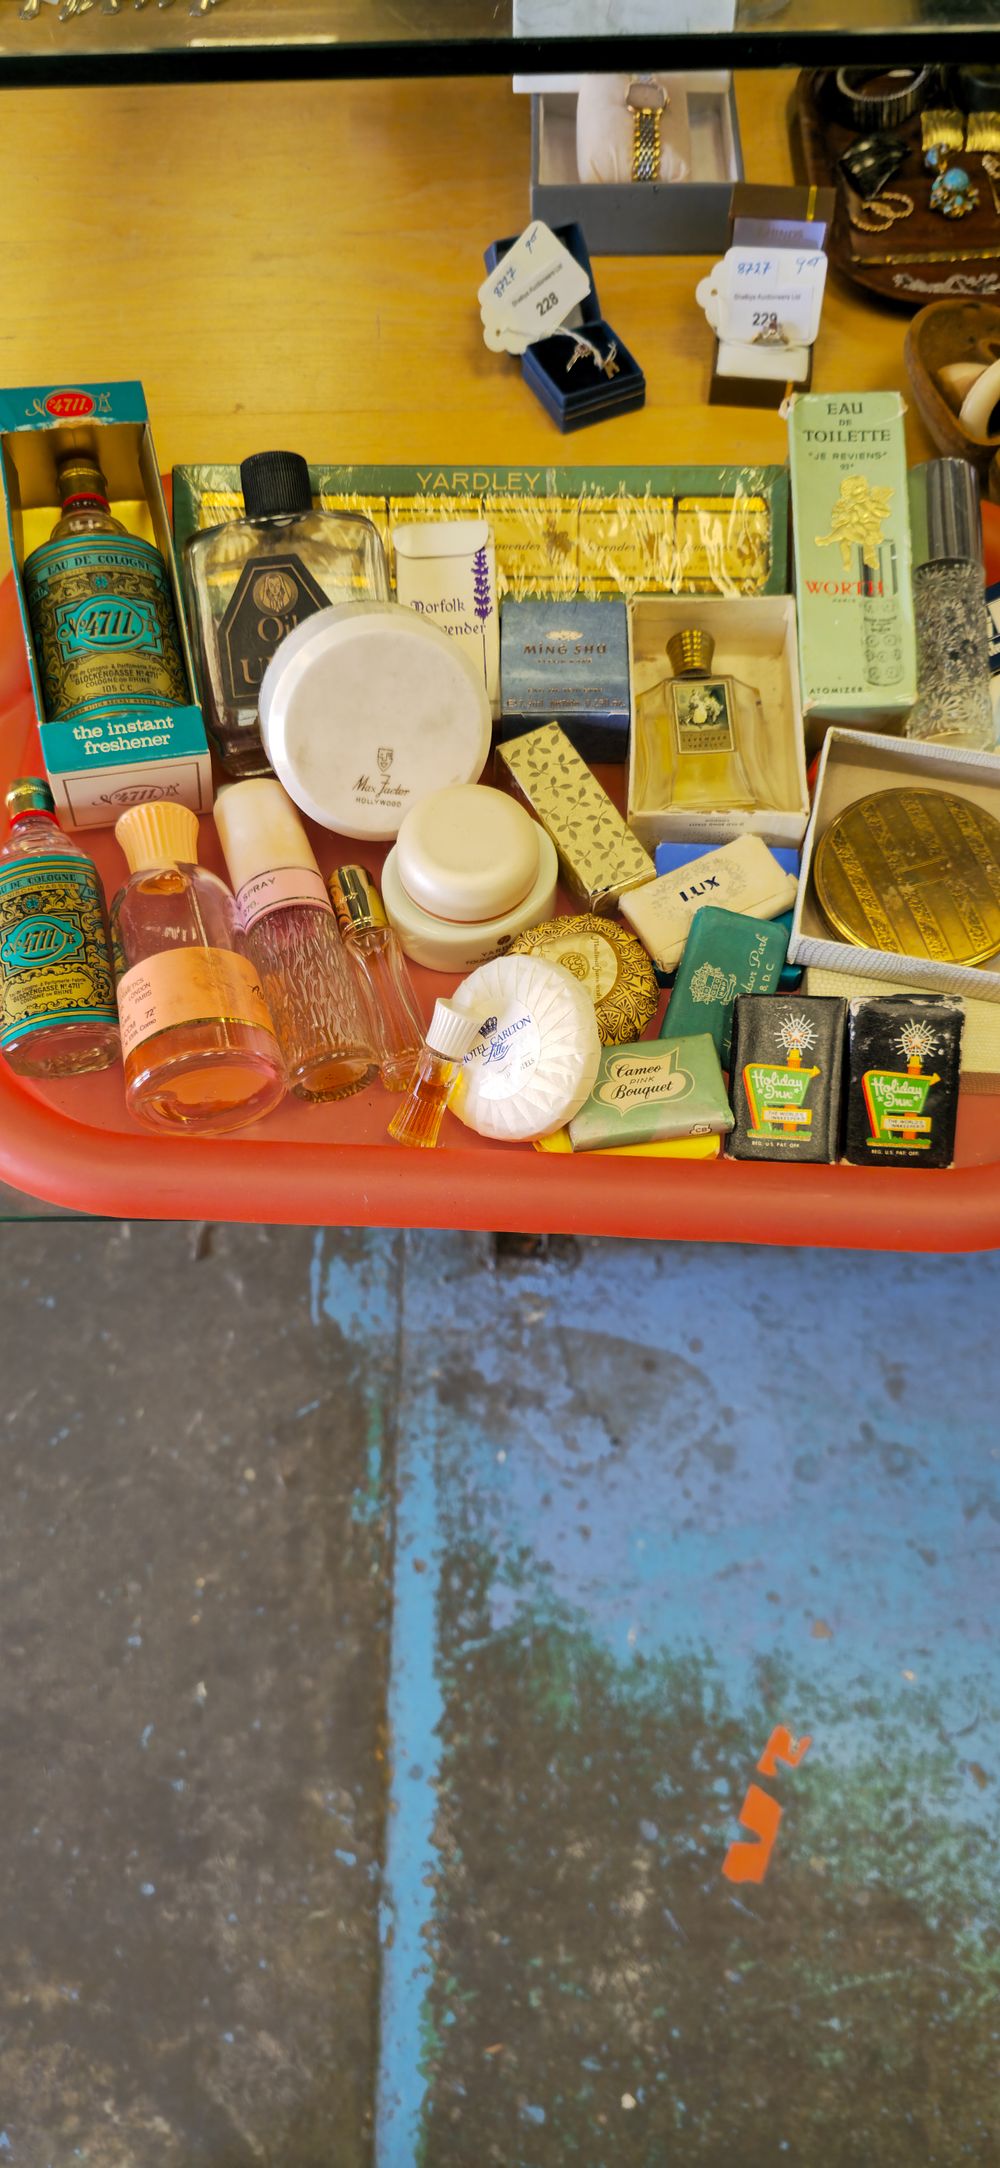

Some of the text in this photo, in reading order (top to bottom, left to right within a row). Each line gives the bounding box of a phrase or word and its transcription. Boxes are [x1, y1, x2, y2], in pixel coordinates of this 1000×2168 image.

[737, 262, 771, 275] 8727
[536, 292, 559, 316] 228
[827, 402, 863, 415] EAU
[803, 429, 891, 442] TOILETTE
[416, 472, 540, 491] YARDLEY
[47, 560, 69, 577] EAU
[75, 557, 91, 567] DE
[805, 580, 885, 597] WORTH
[410, 598, 465, 614] Norfolk
[809, 686, 864, 695] ATOMIZER
[72, 716, 175, 741] the instant
[84, 734, 171, 755] freshener
[352, 774, 410, 798] Max Factor
[355, 797, 402, 808] HOLLYWOOD
[27, 873, 76, 884] COLOGNE
[242, 877, 276, 902] SPRAY
[679, 876, 720, 902] LUX
[749, 933, 768, 968] Park
[490, 1015, 532, 1045] CARLTON
[616, 1063, 662, 1078] Cameo
[629, 1076, 655, 1085] PINK
[752, 1069, 803, 1091] Holiday
[870, 1077, 922, 1099] Holiday
[610, 1081, 673, 1099] Bouquet
[764, 1085, 793, 1099] Inn
[884, 1093, 913, 1107] Inn
